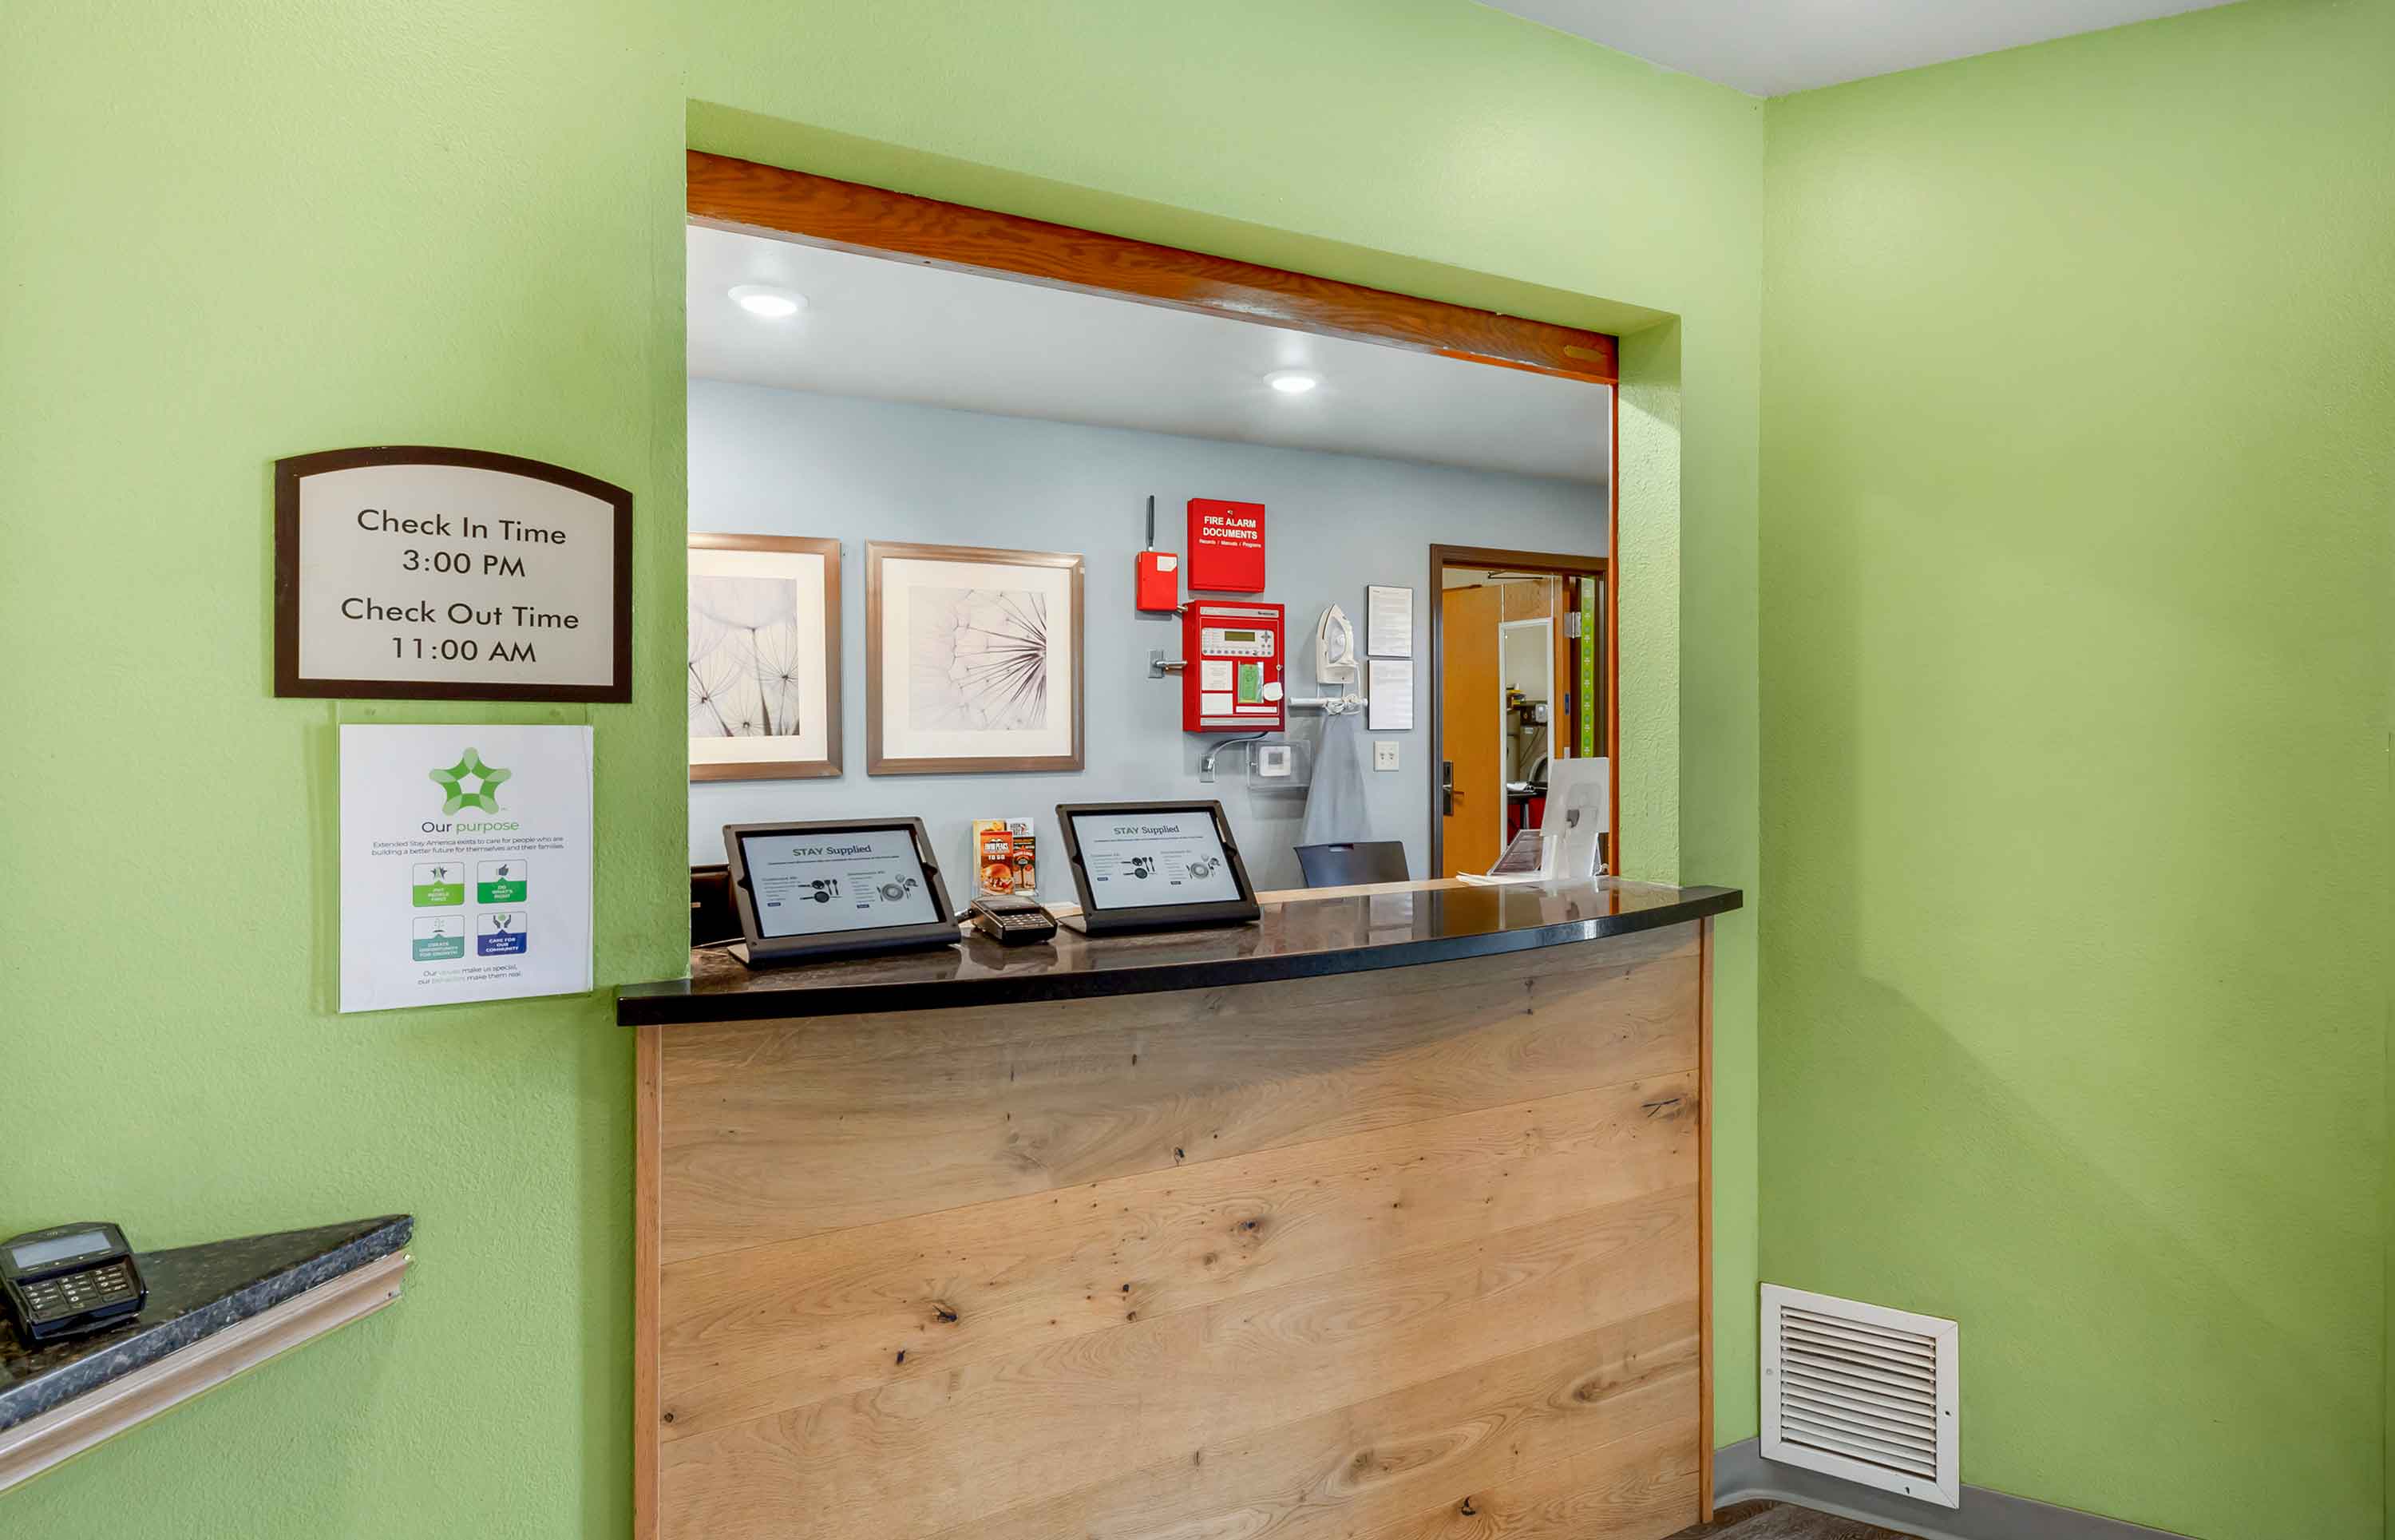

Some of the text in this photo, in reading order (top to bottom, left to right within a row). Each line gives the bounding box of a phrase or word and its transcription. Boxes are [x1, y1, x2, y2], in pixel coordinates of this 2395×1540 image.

[357, 509, 566, 544] Check In Time
[1204, 516, 1256, 528] FIRE ALARM
[1202, 527, 1257, 540] DOCUMENTS
[402, 549, 525, 576] 3:00 PM
[341, 598, 579, 629] Check Out Time
[393, 637, 536, 663] 11:00 AM
[422, 821, 520, 834] Our purpose
[1113, 825, 1180, 836] STAY Supplied
[792, 845, 872, 857] STAY Supplied
